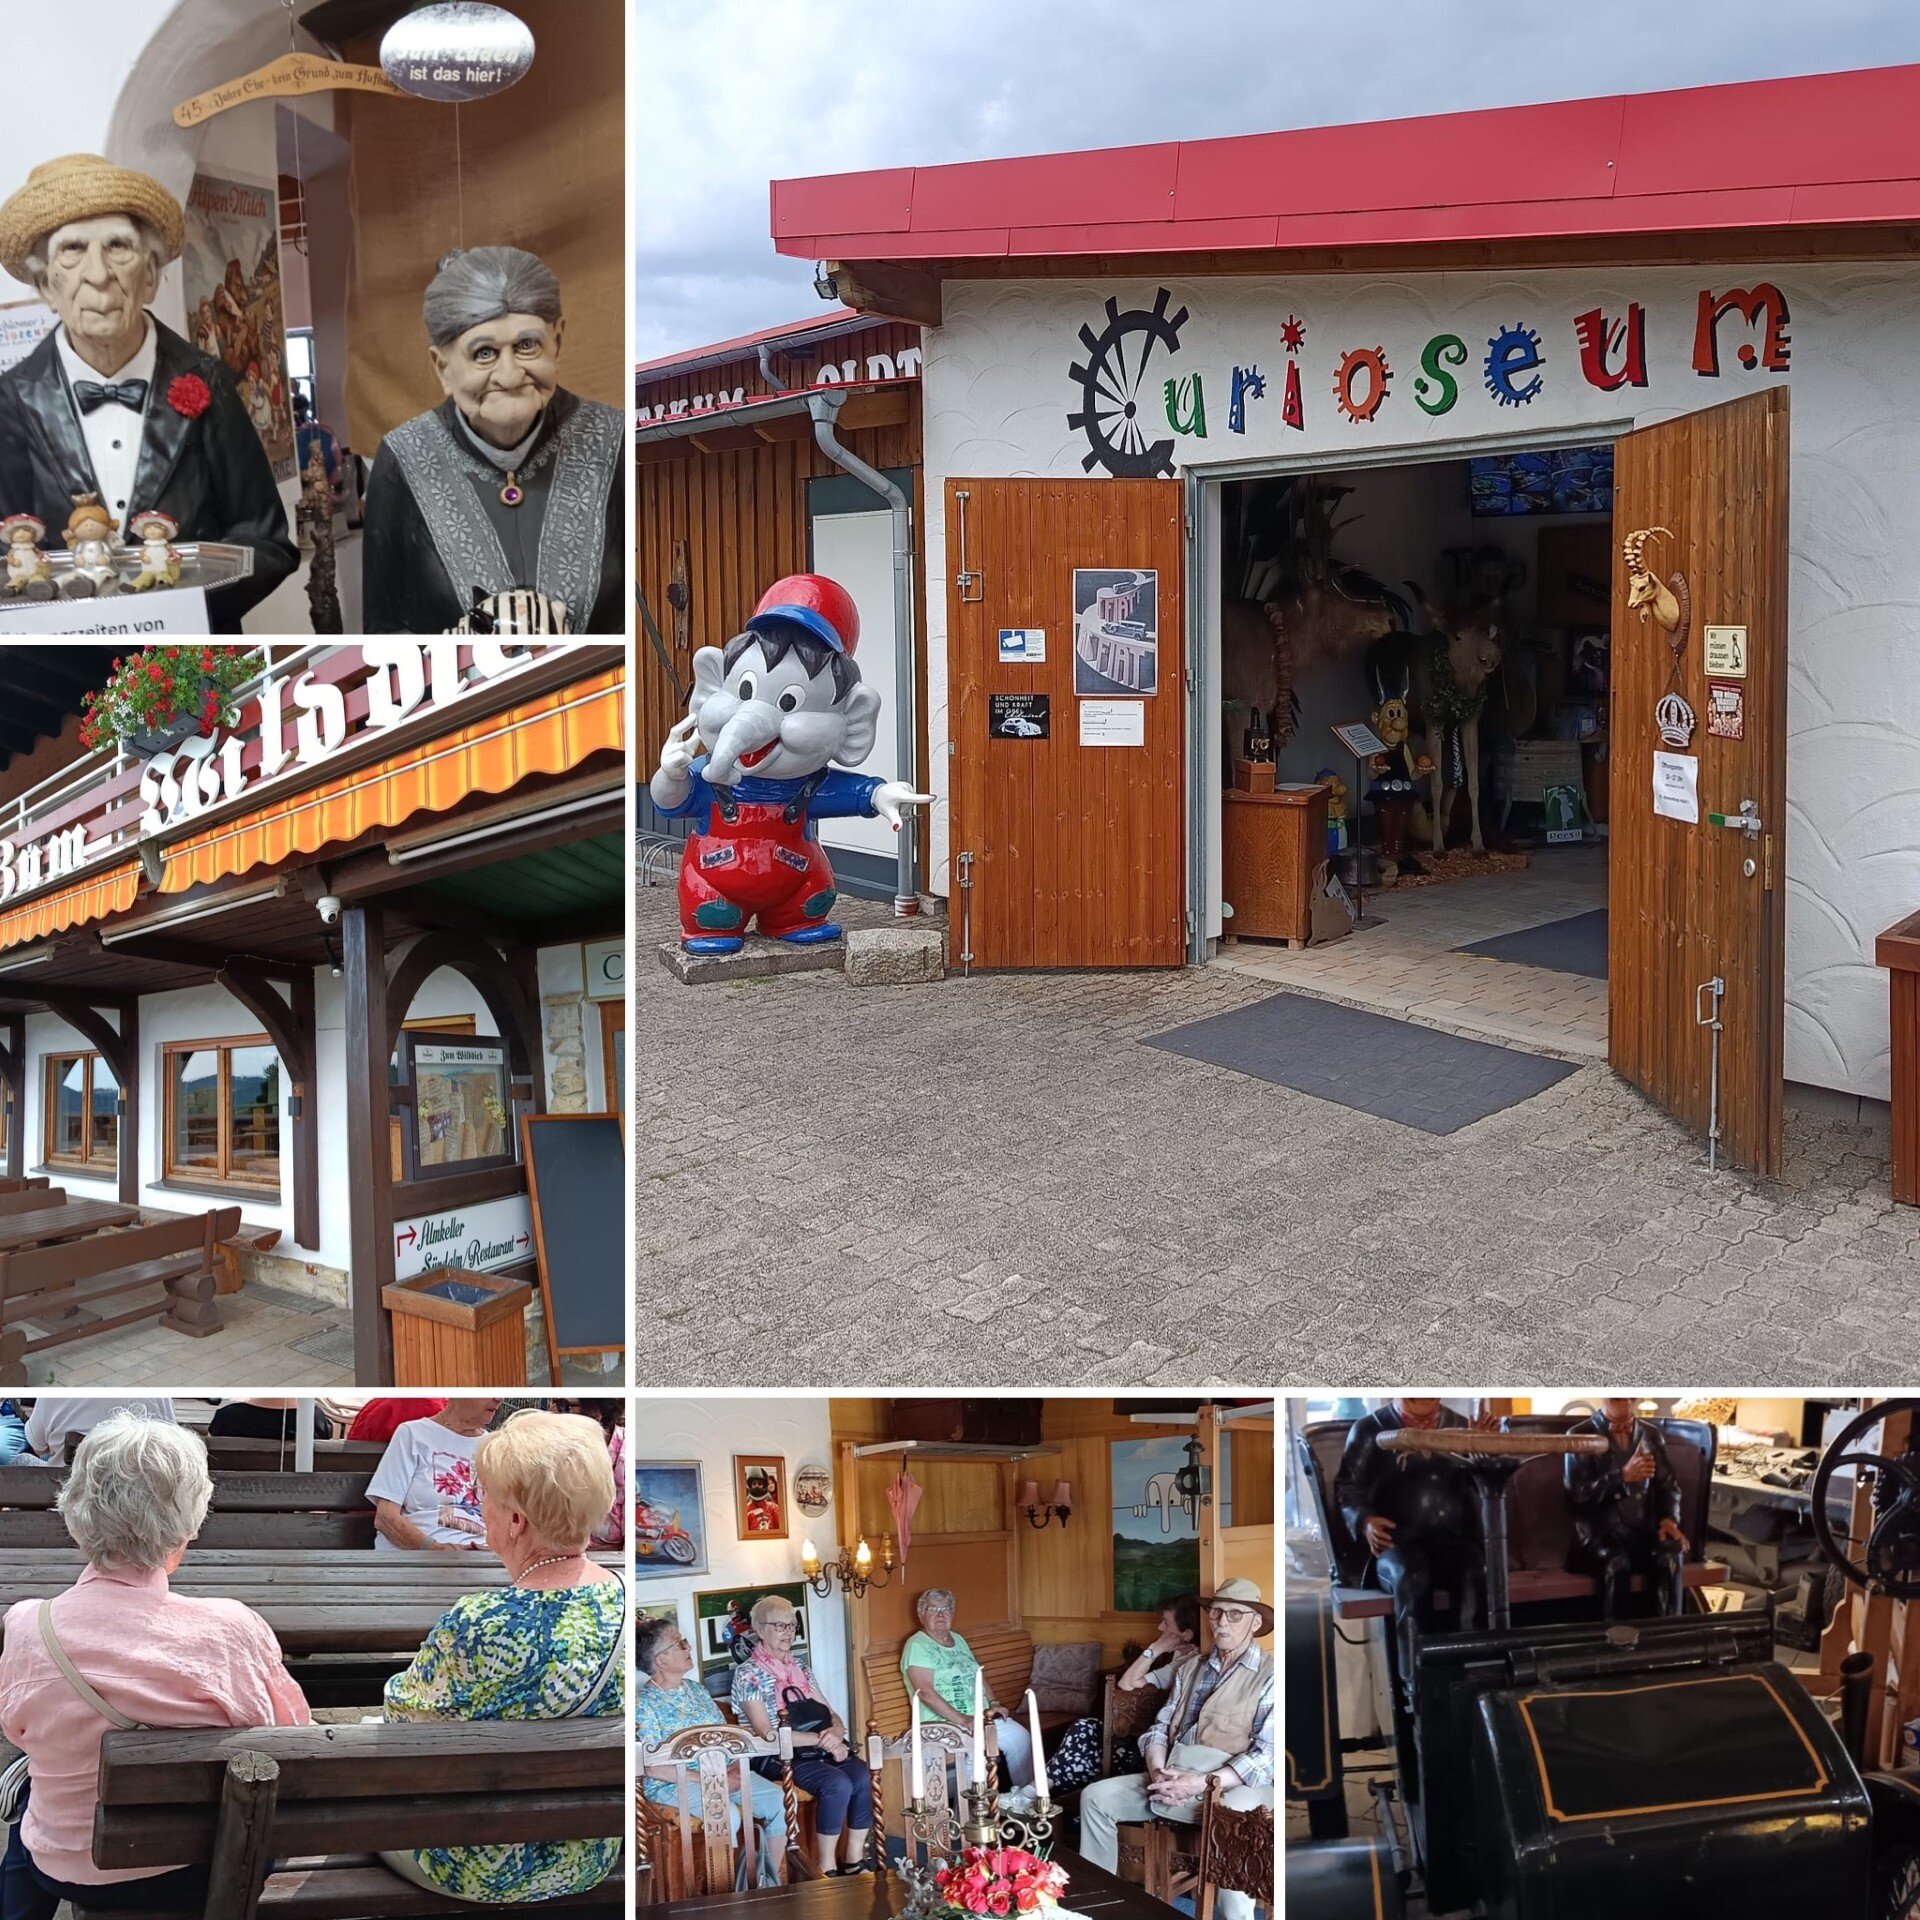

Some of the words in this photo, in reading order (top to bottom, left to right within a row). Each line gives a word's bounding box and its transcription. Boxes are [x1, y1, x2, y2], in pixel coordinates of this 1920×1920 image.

[409, 66, 428, 81] ist
[433, 66, 461, 82] das
[466, 67, 501, 83] hier!
[181, 100, 204, 121] 45
[271, 73, 292, 86] kein
[293, 66, 330, 89] Grund
[1066, 282, 1791, 478] Curioseum
[133, 619, 165, 633] von
[440, 1050, 455, 1062] Zum
[416, 1217, 465, 1251] Almkeller
